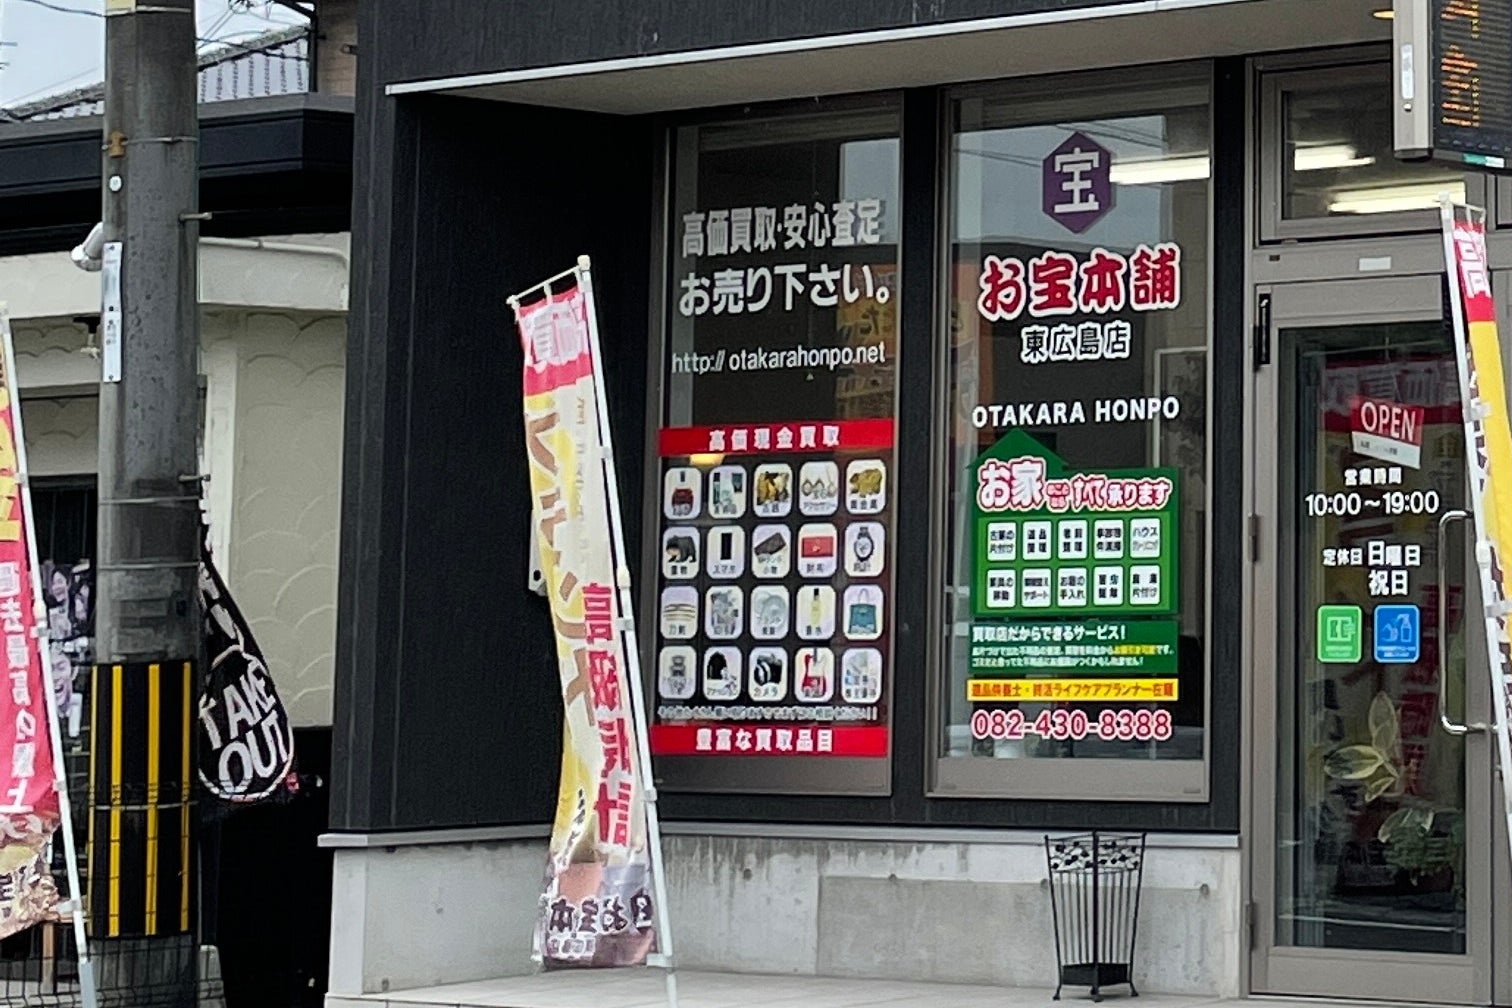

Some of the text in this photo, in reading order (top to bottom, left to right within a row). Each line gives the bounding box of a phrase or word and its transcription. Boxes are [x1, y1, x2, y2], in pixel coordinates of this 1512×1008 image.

[1054, 147, 1099, 213] 宝
[679, 263, 891, 317] お売り下さい。
[978, 242, 1181, 322] お宝本舗
[672, 340, 886, 375] http:// otakarahonpo.net
[1020, 320, 1132, 363] 東広島店
[972, 396, 1180, 428] OTAKARA HONPO
[1360, 401, 1417, 442] OPEN
[709, 425, 840, 451] 高価現金買取
[1344, 467, 1402, 486] 営業時間
[1322, 540, 1421, 567] 定休日 日曜日
[1368, 569, 1409, 597] 祝日
[696, 727, 833, 752] 豊富な買取品目
[971, 709, 1172, 741] 082-430-8388
[218, 710, 288, 795] OUT
